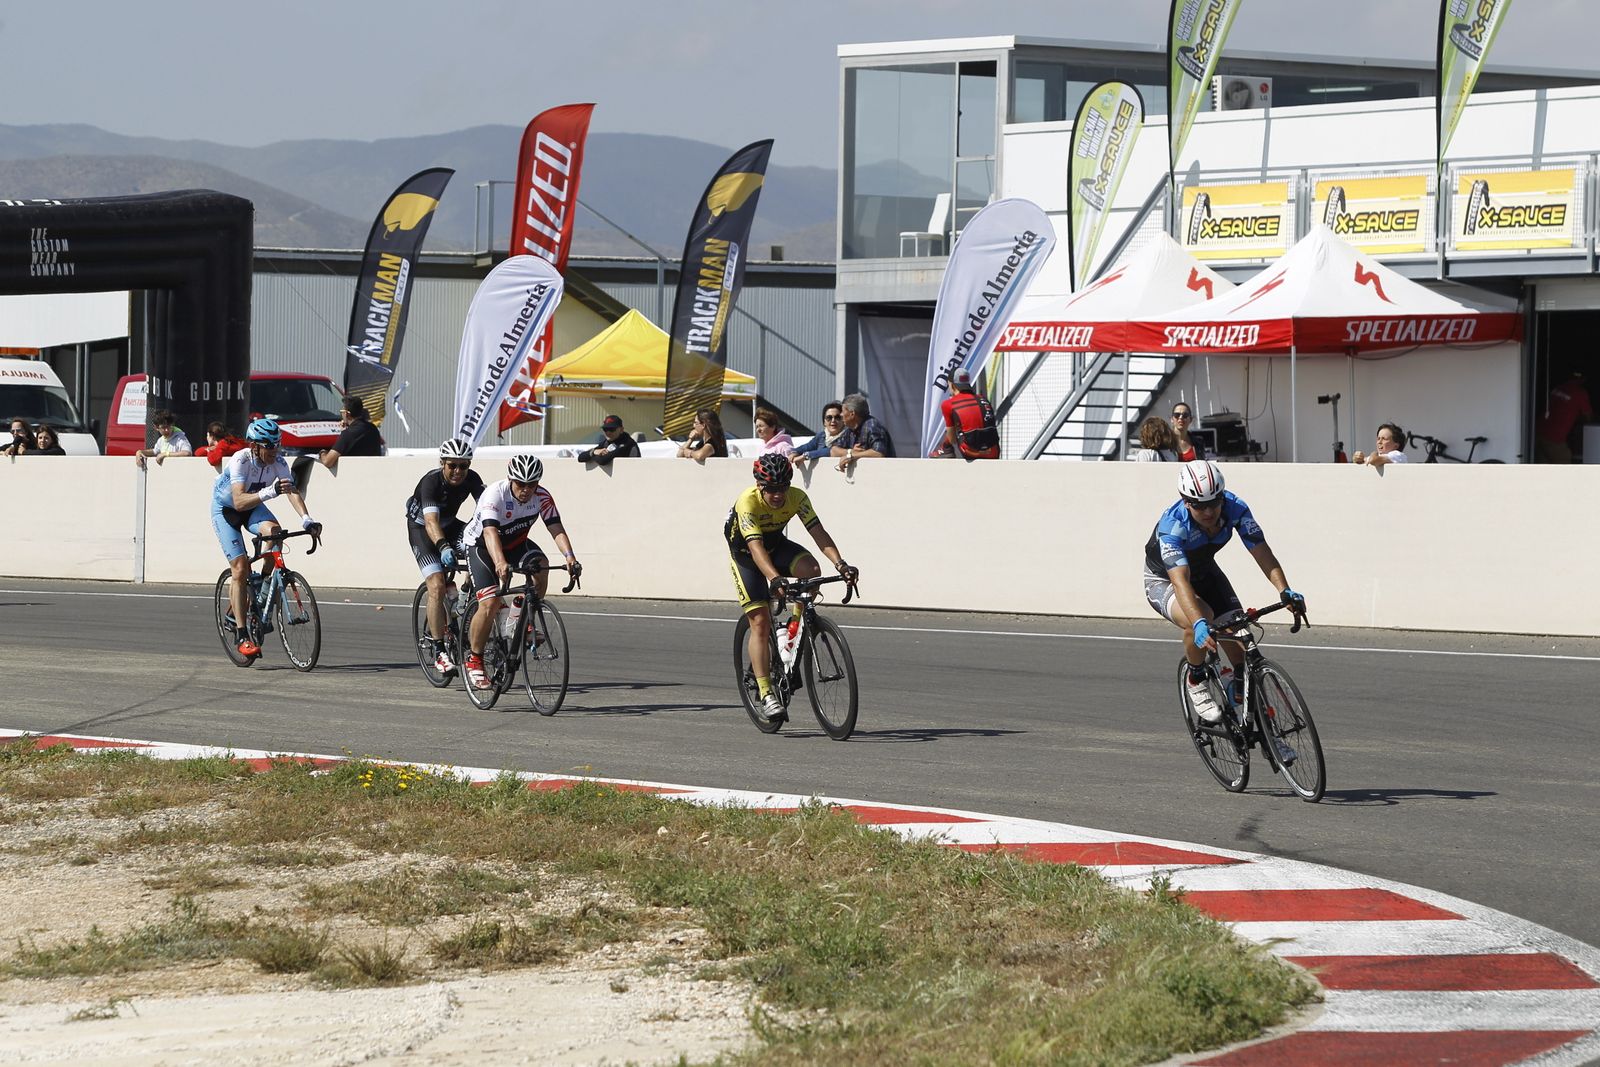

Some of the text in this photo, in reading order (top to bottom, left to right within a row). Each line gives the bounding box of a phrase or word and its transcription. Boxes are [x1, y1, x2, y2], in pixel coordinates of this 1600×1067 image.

[1191, 0, 1225, 64] X-SAU
[1467, 0, 1496, 43] X-S
[1093, 98, 1135, 194] X-SAUCE
[1200, 215, 1281, 239] X-SAUCE
[1335, 209, 1420, 235] X-SAUCE
[1480, 204, 1567, 229] X-SAUCE
[31, 227, 48, 240] THE
[31, 239, 69, 252] CUSTOM
[31, 262, 75, 277] COMPANY
[32, 251, 58, 264] WEAR
[686, 237, 731, 354] TRACKMAN
[359, 252, 403, 364] TRACKMAN
[932, 229, 1037, 393] Diario de Almería
[999, 326, 1094, 347] SPECIALIZED
[1162, 324, 1259, 347] SPECIALIZED
[1341, 319, 1477, 342] SPECIALIZED
[459, 283, 548, 437] Diario de Almería
[190, 381, 245, 401] GOBIK
